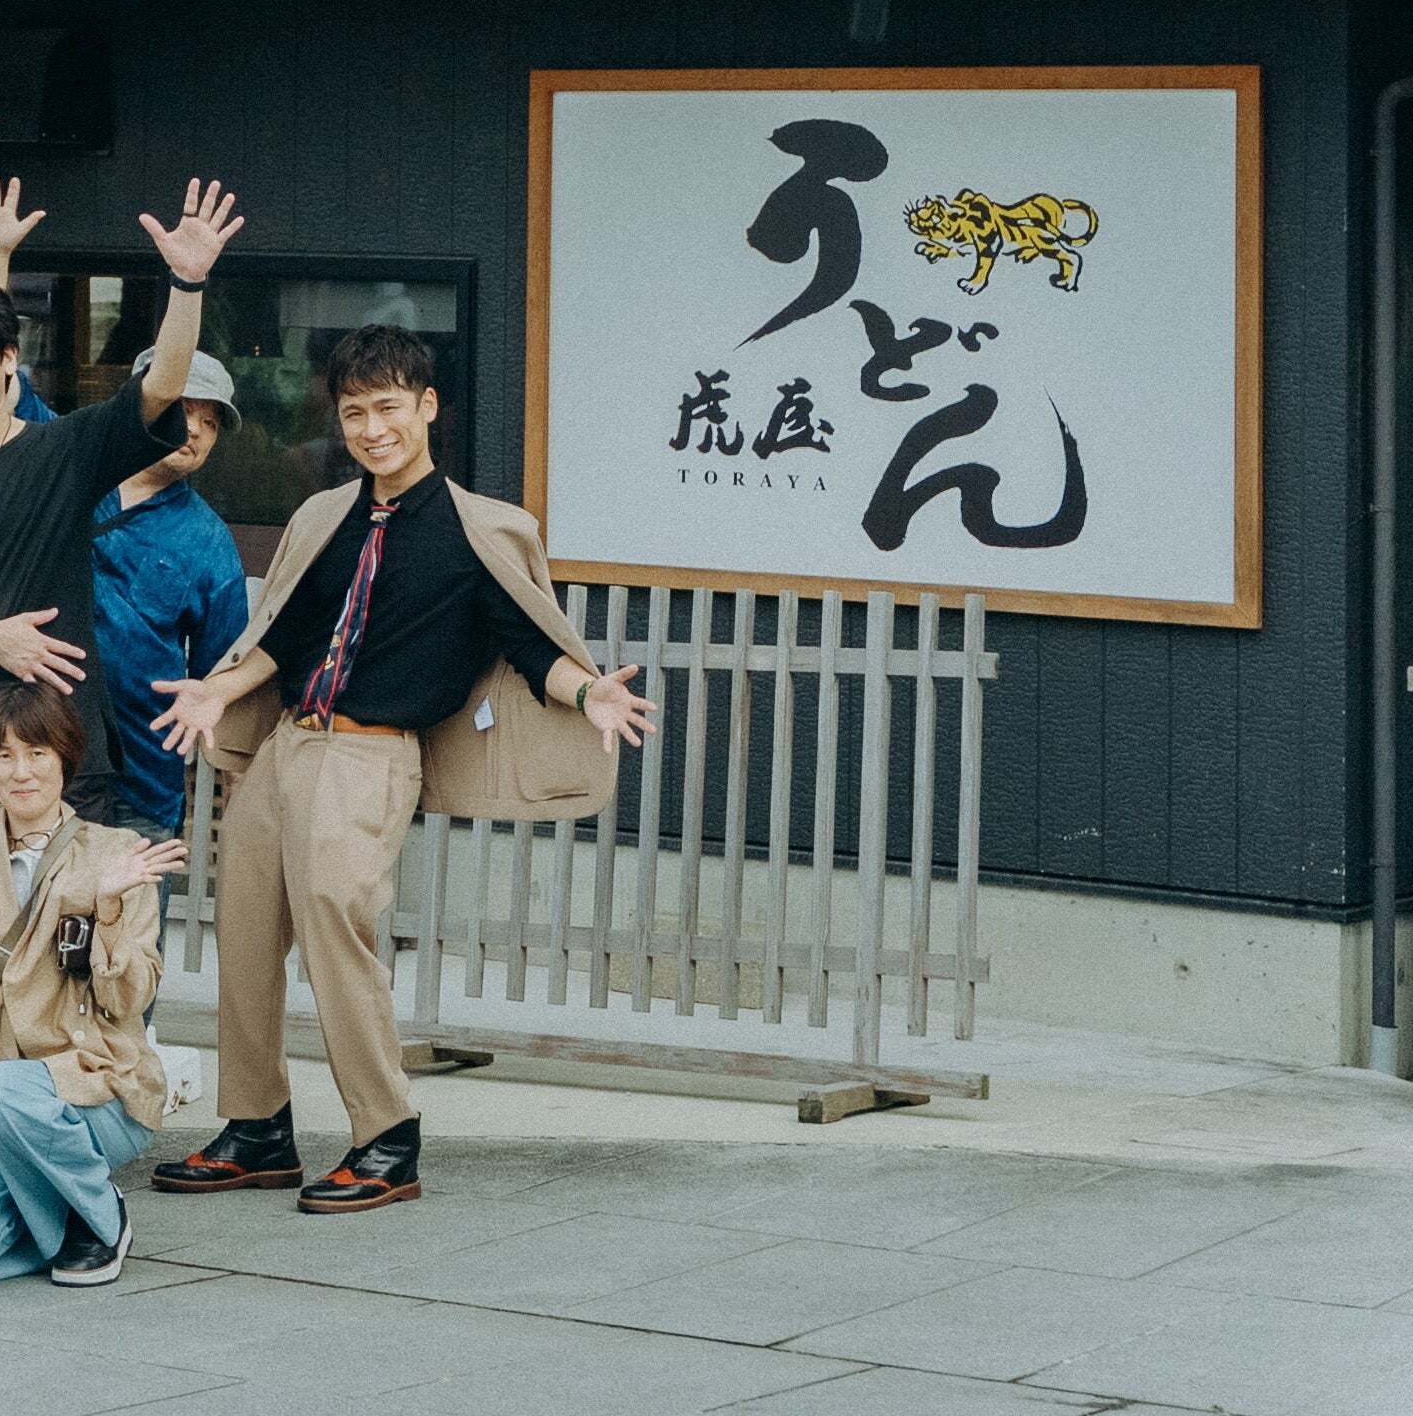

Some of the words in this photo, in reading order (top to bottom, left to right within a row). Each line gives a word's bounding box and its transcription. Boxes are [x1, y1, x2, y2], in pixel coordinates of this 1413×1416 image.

[732, 118, 1089, 553] うどん
[669, 369, 835, 460] 虎屋
[677, 468, 827, 492] TORAYA
